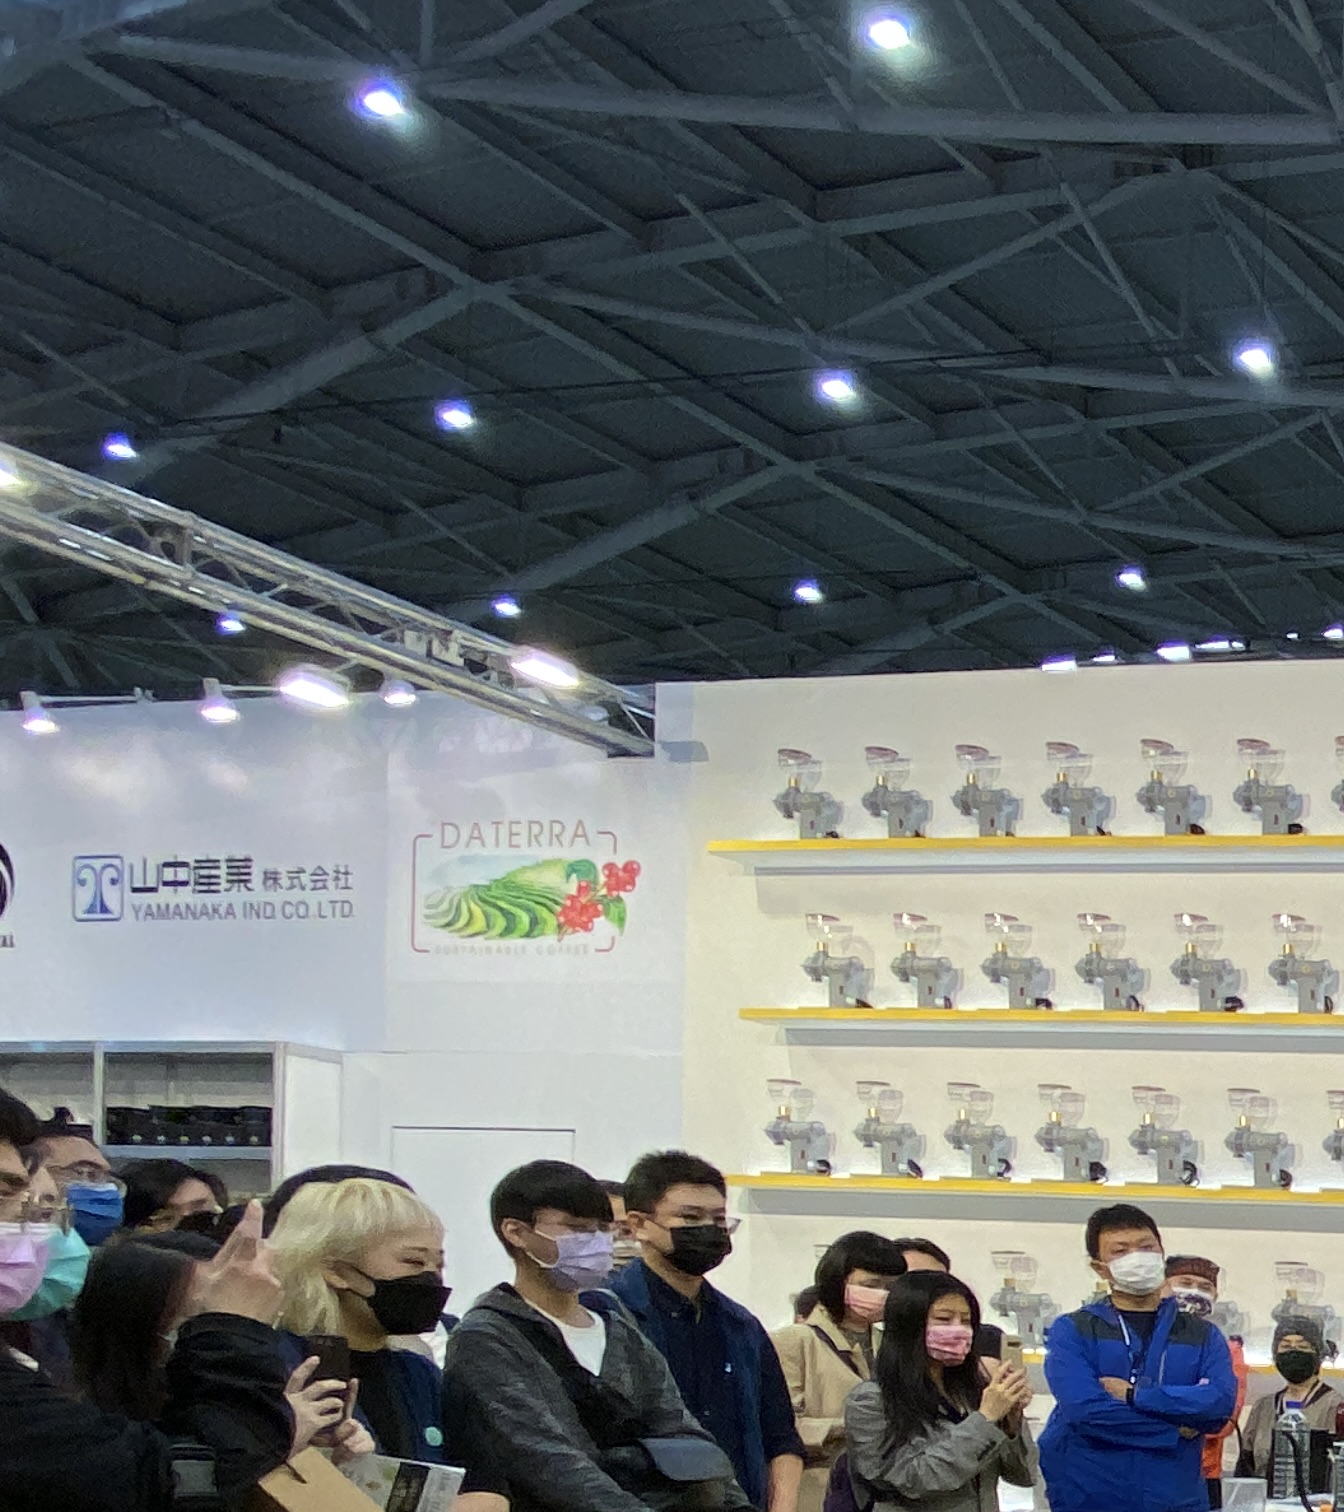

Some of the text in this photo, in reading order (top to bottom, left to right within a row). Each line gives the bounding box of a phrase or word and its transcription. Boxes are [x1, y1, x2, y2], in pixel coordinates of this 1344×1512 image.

[440, 819, 591, 849] DATERRA
[129, 854, 354, 894] 山中産業 株式会社
[131, 902, 237, 921] YAMANAKA
